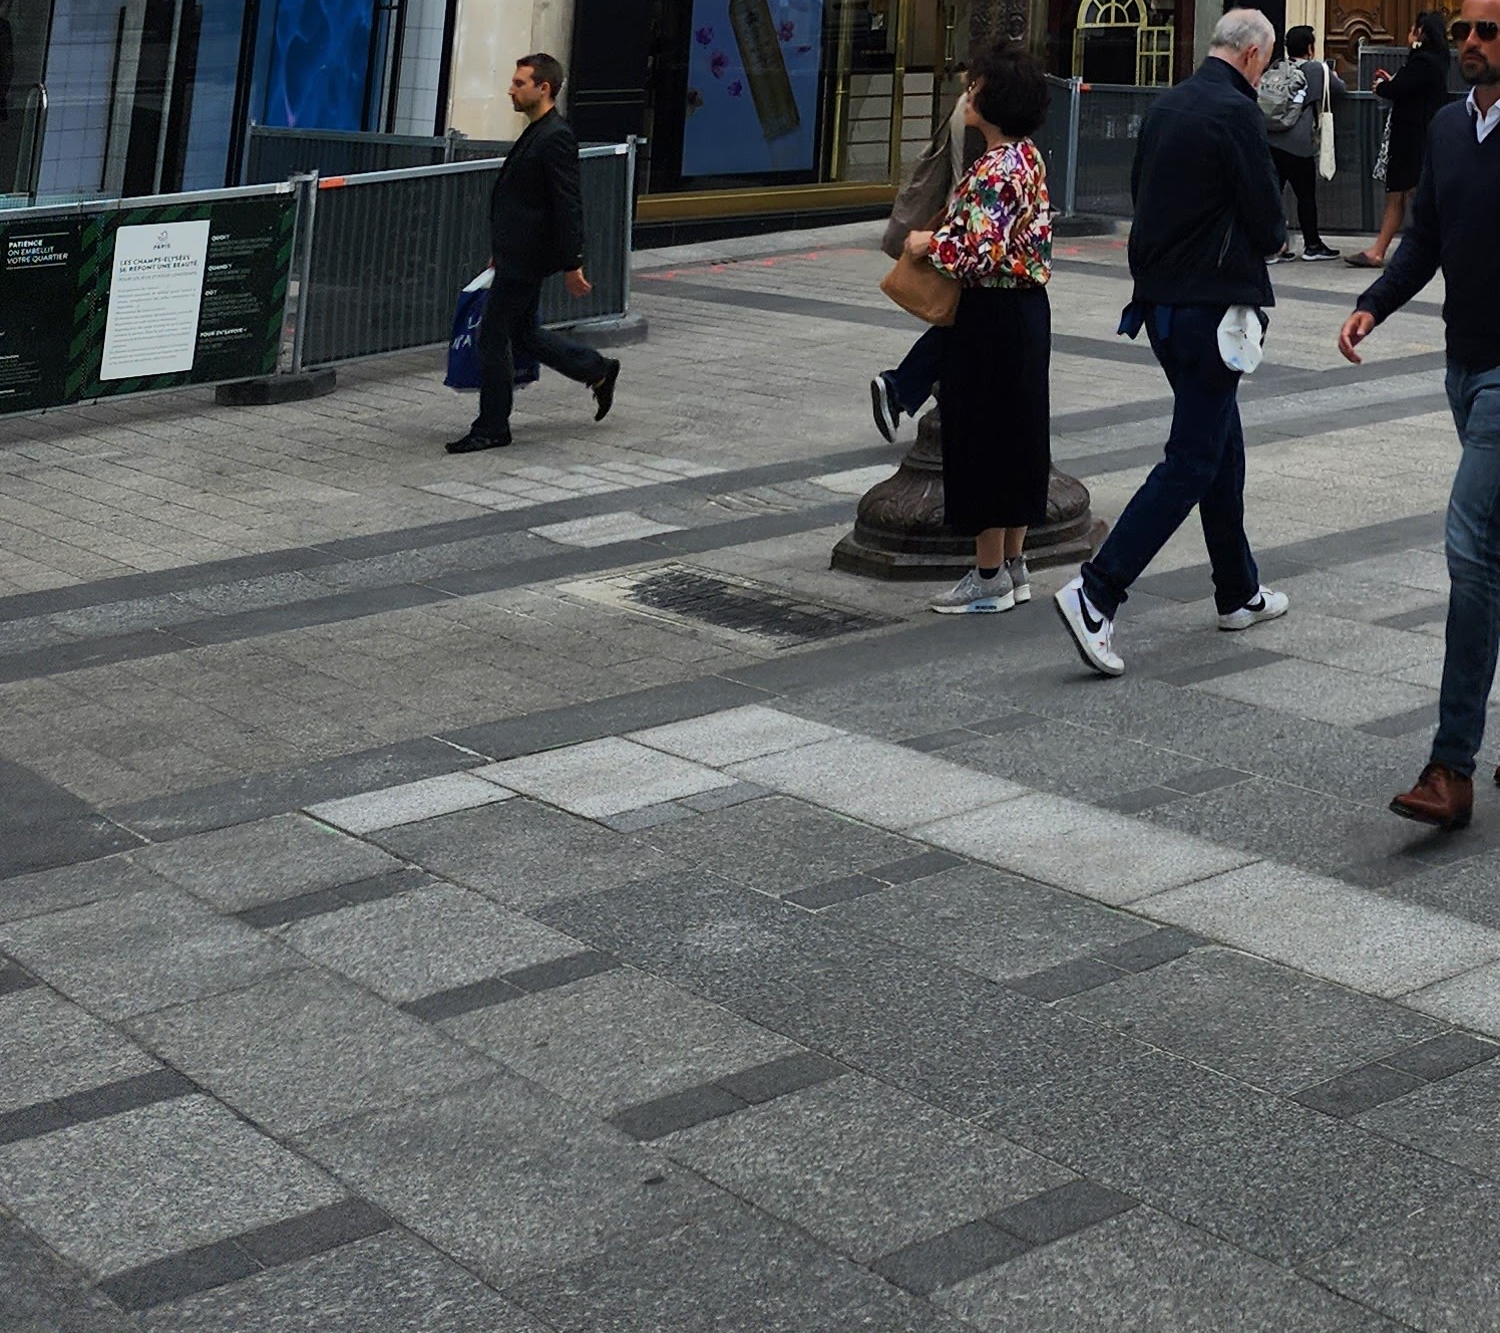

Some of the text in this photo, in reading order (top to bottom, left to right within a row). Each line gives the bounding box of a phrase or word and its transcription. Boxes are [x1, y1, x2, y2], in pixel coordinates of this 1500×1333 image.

[8, 239, 43, 249] PATIENCE
[7, 249, 20, 257] ON
[7, 253, 69, 265] VOTRE QUARTIER
